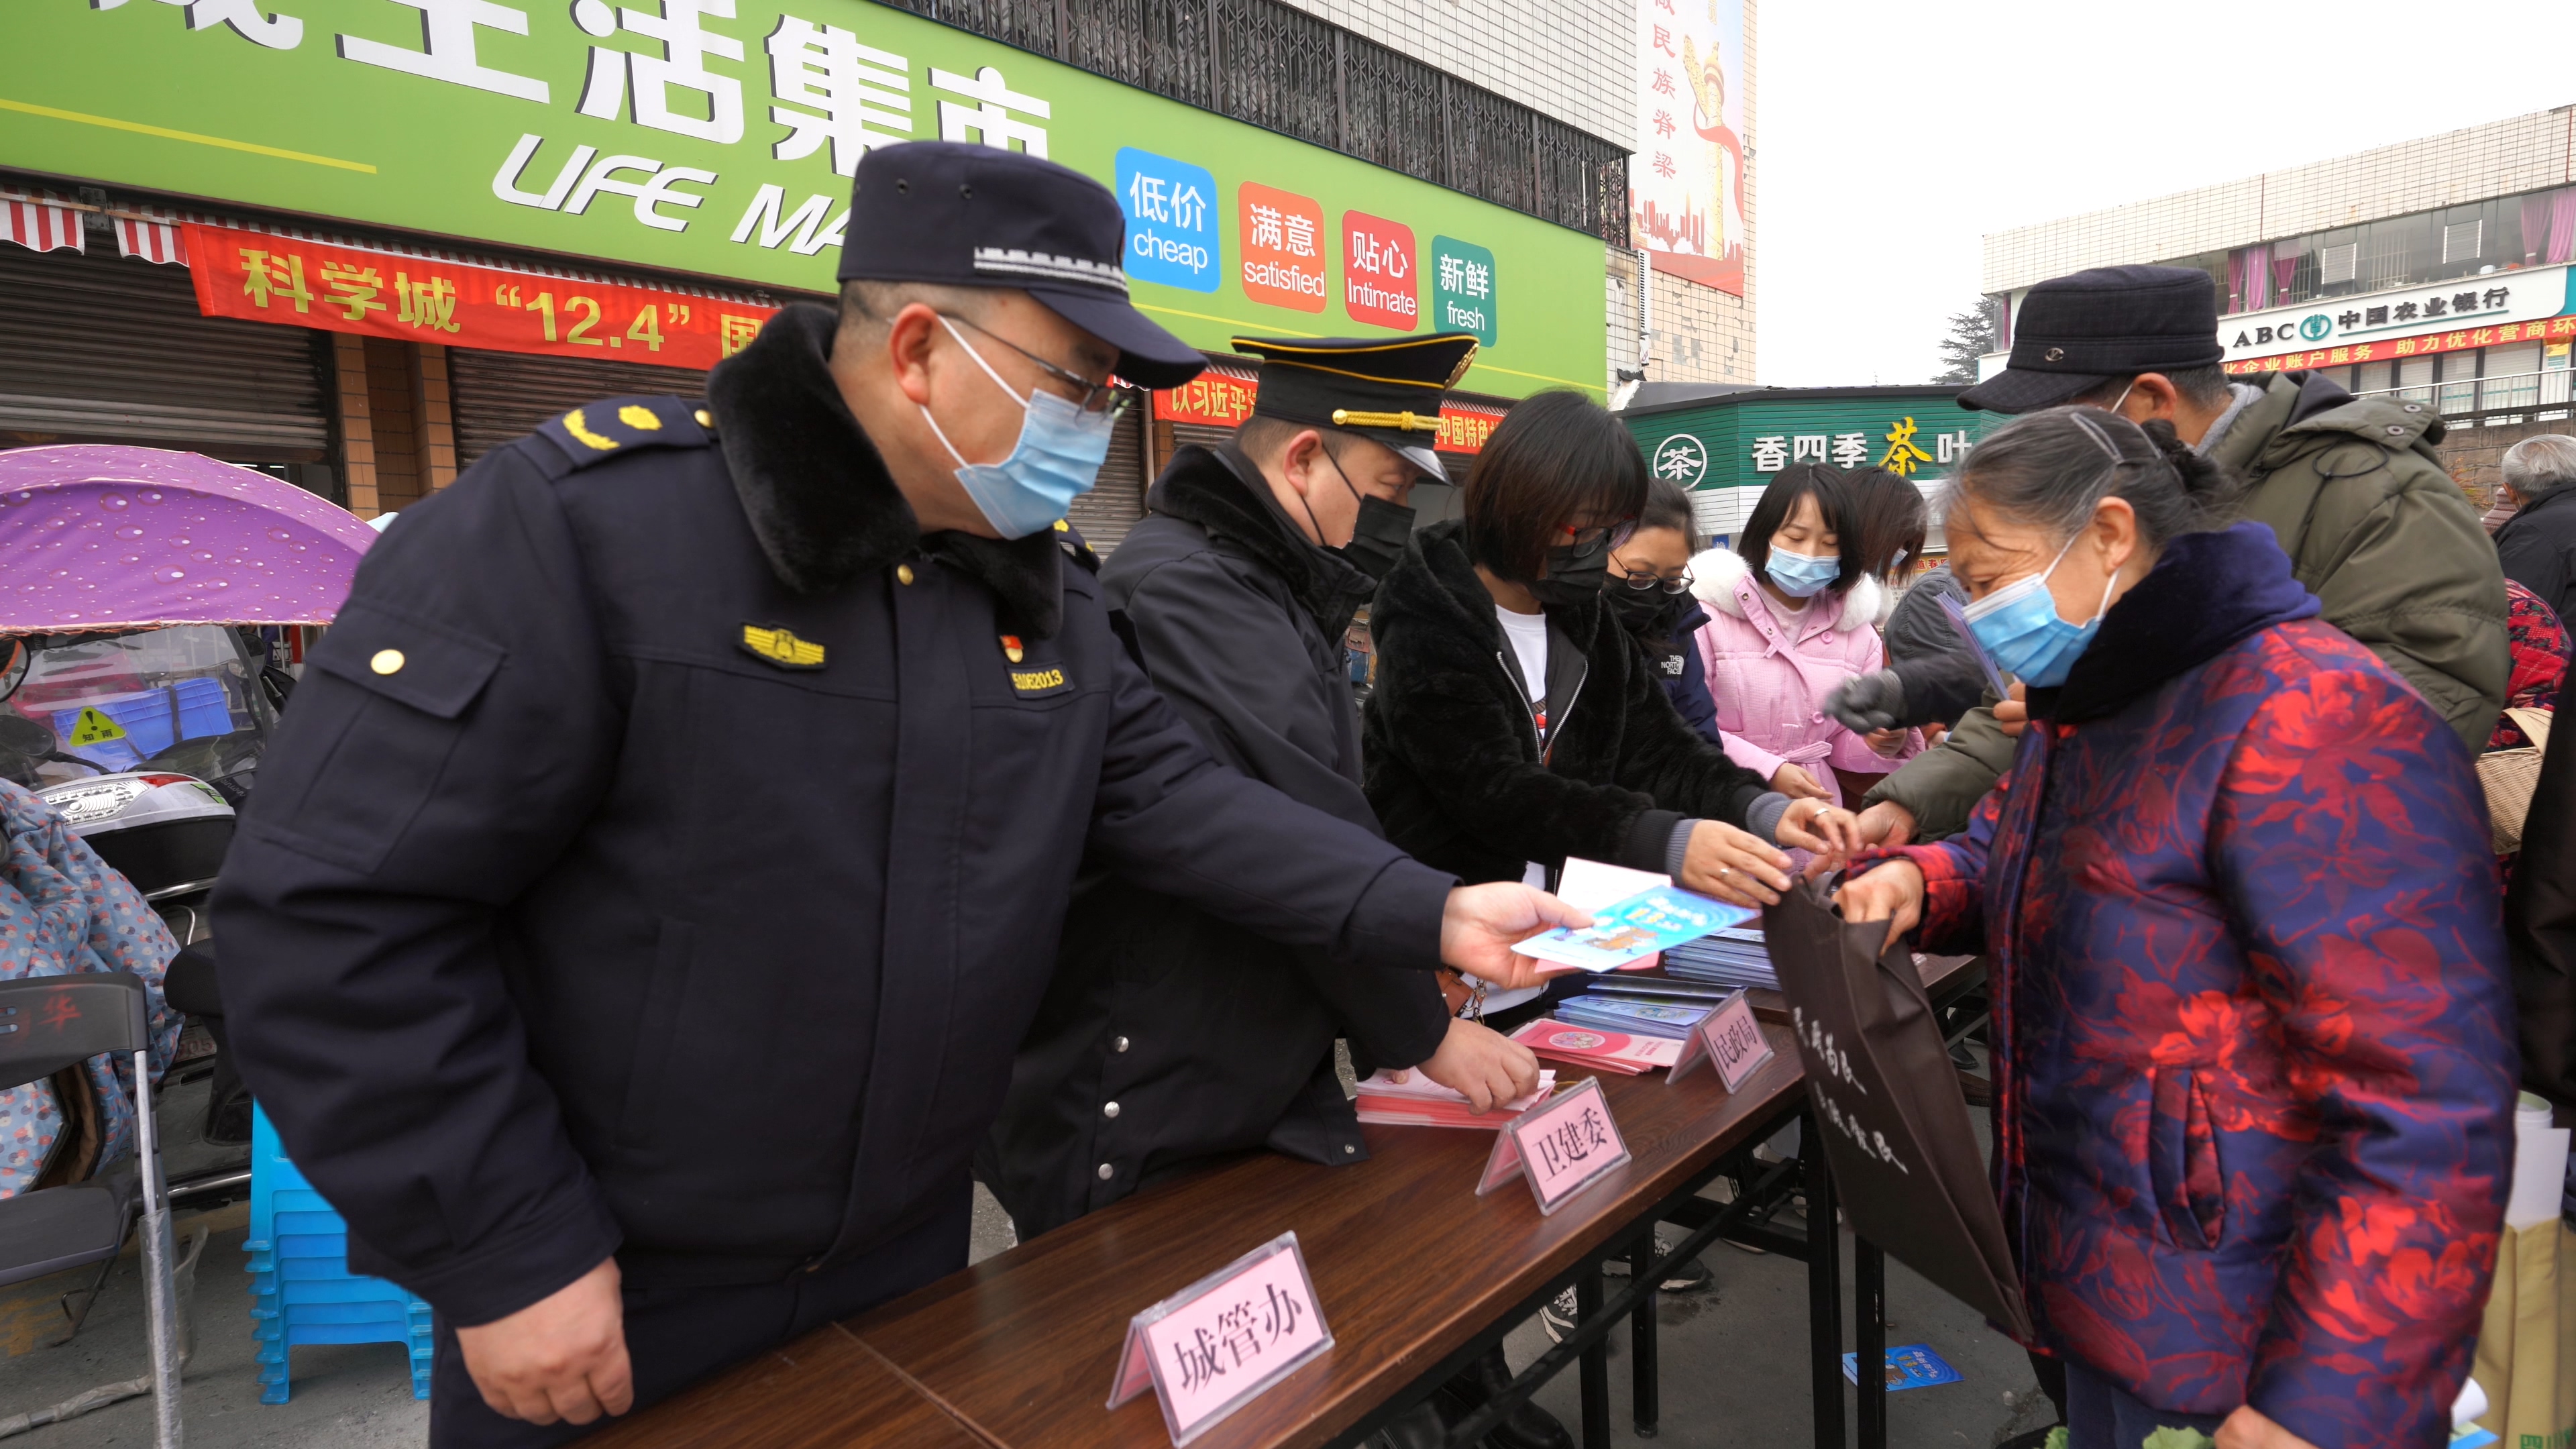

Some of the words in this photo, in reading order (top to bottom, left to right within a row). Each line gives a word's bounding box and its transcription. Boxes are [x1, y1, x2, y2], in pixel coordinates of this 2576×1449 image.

[89, 0, 1051, 178] 生活集市
[492, 133, 719, 233] LIFE
[1129, 170, 1206, 232] 低价
[1133, 228, 1208, 274] cheap
[1248, 203, 1316, 258] 满意
[1352, 230, 1409, 278] 贴心
[239, 248, 461, 333] 科学城
[1244, 260, 1326, 299] satisfied
[1348, 277, 1417, 317] Intimate
[1440, 254, 1489, 300] 新鲜
[1447, 300, 1485, 332] fresh
[2338, 286, 2511, 330] 中国农业银行
[2233, 322, 2295, 349] ABC
[2395, 317, 2576, 356] 助力优化营商环
[1658, 445, 1703, 480] 茶
[1752, 416, 1973, 477] 香四季茶叶
[1660, 661, 1680, 669] NORTH
[1714, 1015, 1758, 1071] 民政局
[1532, 1108, 1608, 1183] 卫建委
[1173, 1282, 1303, 1394] 城管办
